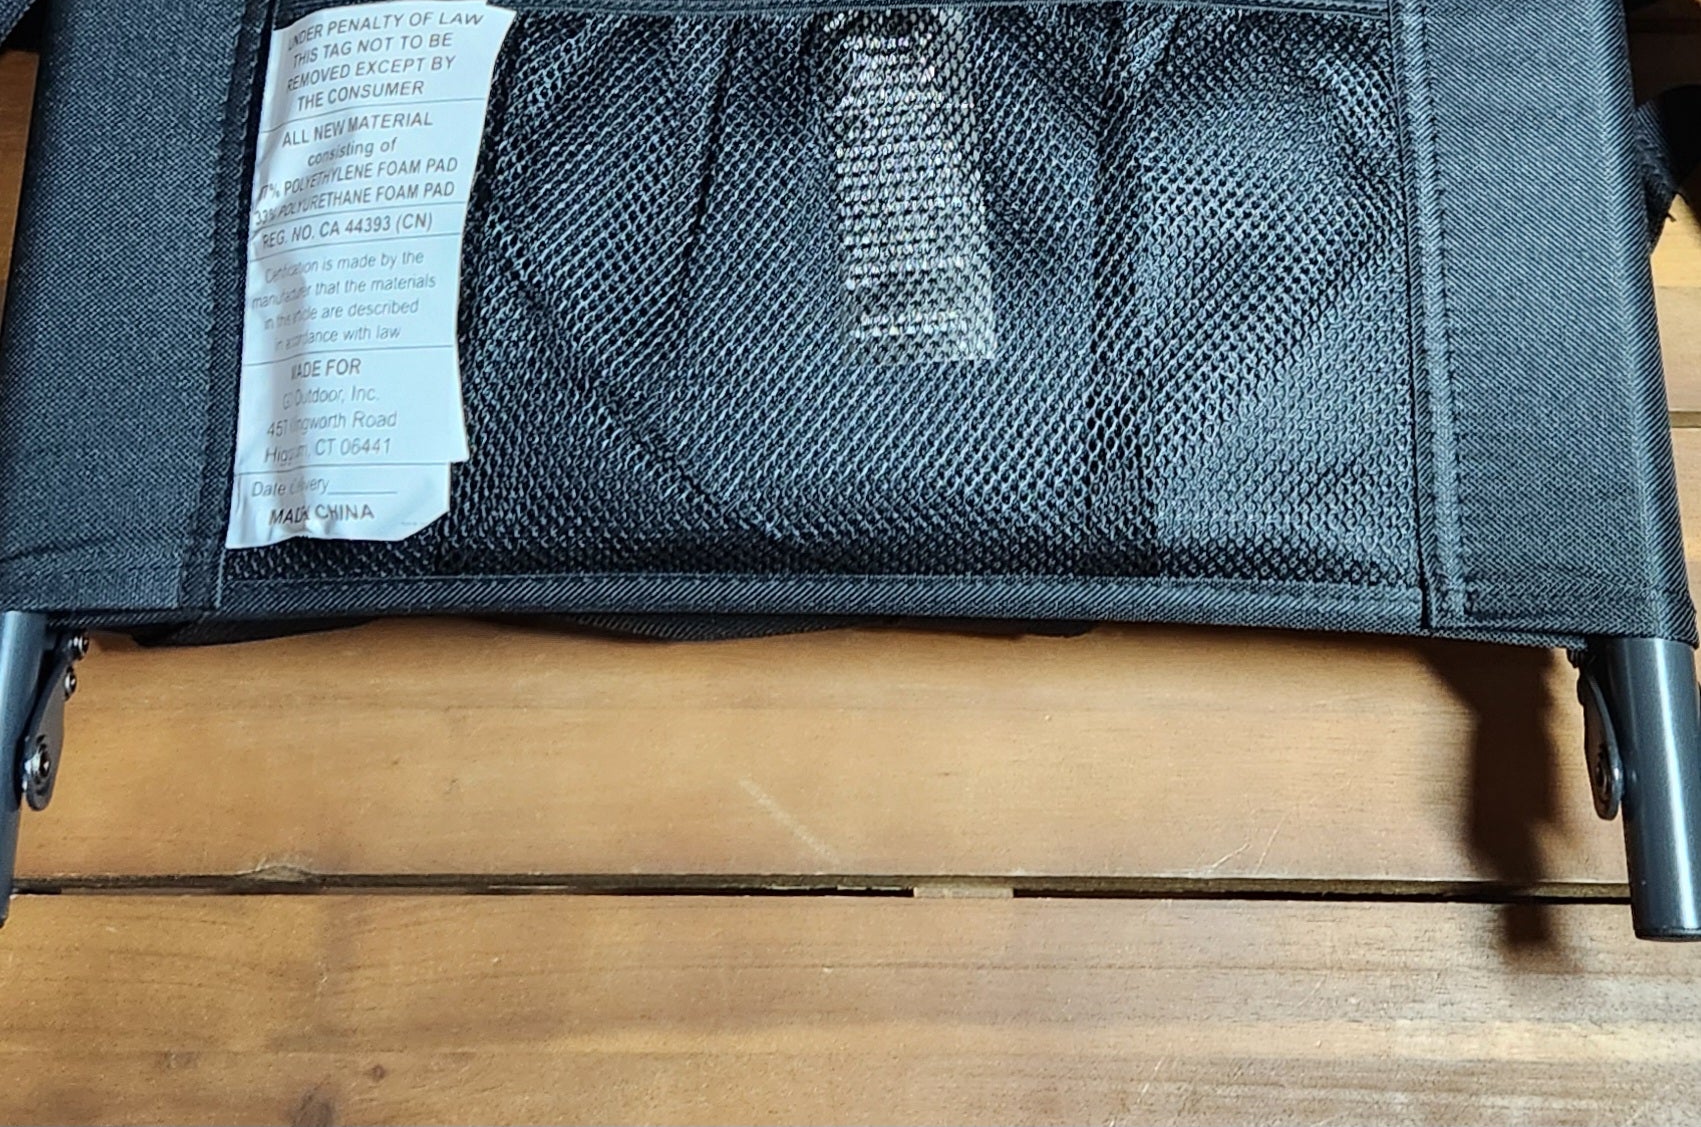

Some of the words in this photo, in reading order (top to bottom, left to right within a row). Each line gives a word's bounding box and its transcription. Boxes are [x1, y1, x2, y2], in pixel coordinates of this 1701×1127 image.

[327, 13, 404, 36] PENALTY
[409, 12, 434, 27] OF
[439, 12, 484, 25] LAW
[294, 47, 319, 68] THIS
[323, 41, 352, 59] TAG
[357, 37, 394, 53] NOT
[401, 35, 423, 50] TO
[428, 32, 453, 48] BE
[287, 64, 350, 93] REMOVED
[355, 57, 426, 76] EXCEPT
[431, 55, 456, 71] BY
[298, 91, 324, 111] THE
[328, 80, 425, 104] CONSUMER
[282, 130, 309, 147] ALL
[314, 119, 346, 140] NEW
[347, 112, 433, 132] MATERIAL
[308, 140, 374, 167] consisting
[380, 136, 397, 152] of
[284, 162, 373, 195] POLYETHYLENE
[378, 159, 421, 177] FOAM
[425, 157, 458, 173] PAD
[375, 184, 419, 202] FOAM
[423, 181, 455, 198] PAD
[262, 229, 288, 248] REG.
[291, 224, 315, 243] NO.
[319, 220, 340, 237] CA
[345, 215, 391, 233] 44393
[396, 212, 433, 234] (CN)
[322, 257, 333, 271] is
[336, 254, 376, 269] made
[380, 253, 397, 270] by
[402, 251, 424, 265] the
[315, 281, 340, 295] that
[344, 279, 367, 293] the
[370, 273, 436, 291] materials
[321, 305, 343, 318] are
[347, 298, 419, 317] described
[343, 326, 371, 341] with
[376, 325, 401, 340] law
[325, 358, 362, 376] FOR
[351, 386, 379, 401] Inc.
[352, 410, 398, 428] Road
[315, 438, 336, 456] CT
[340, 438, 391, 456] 06441
[251, 481, 287, 497] Date
[314, 504, 374, 521] CHINA
